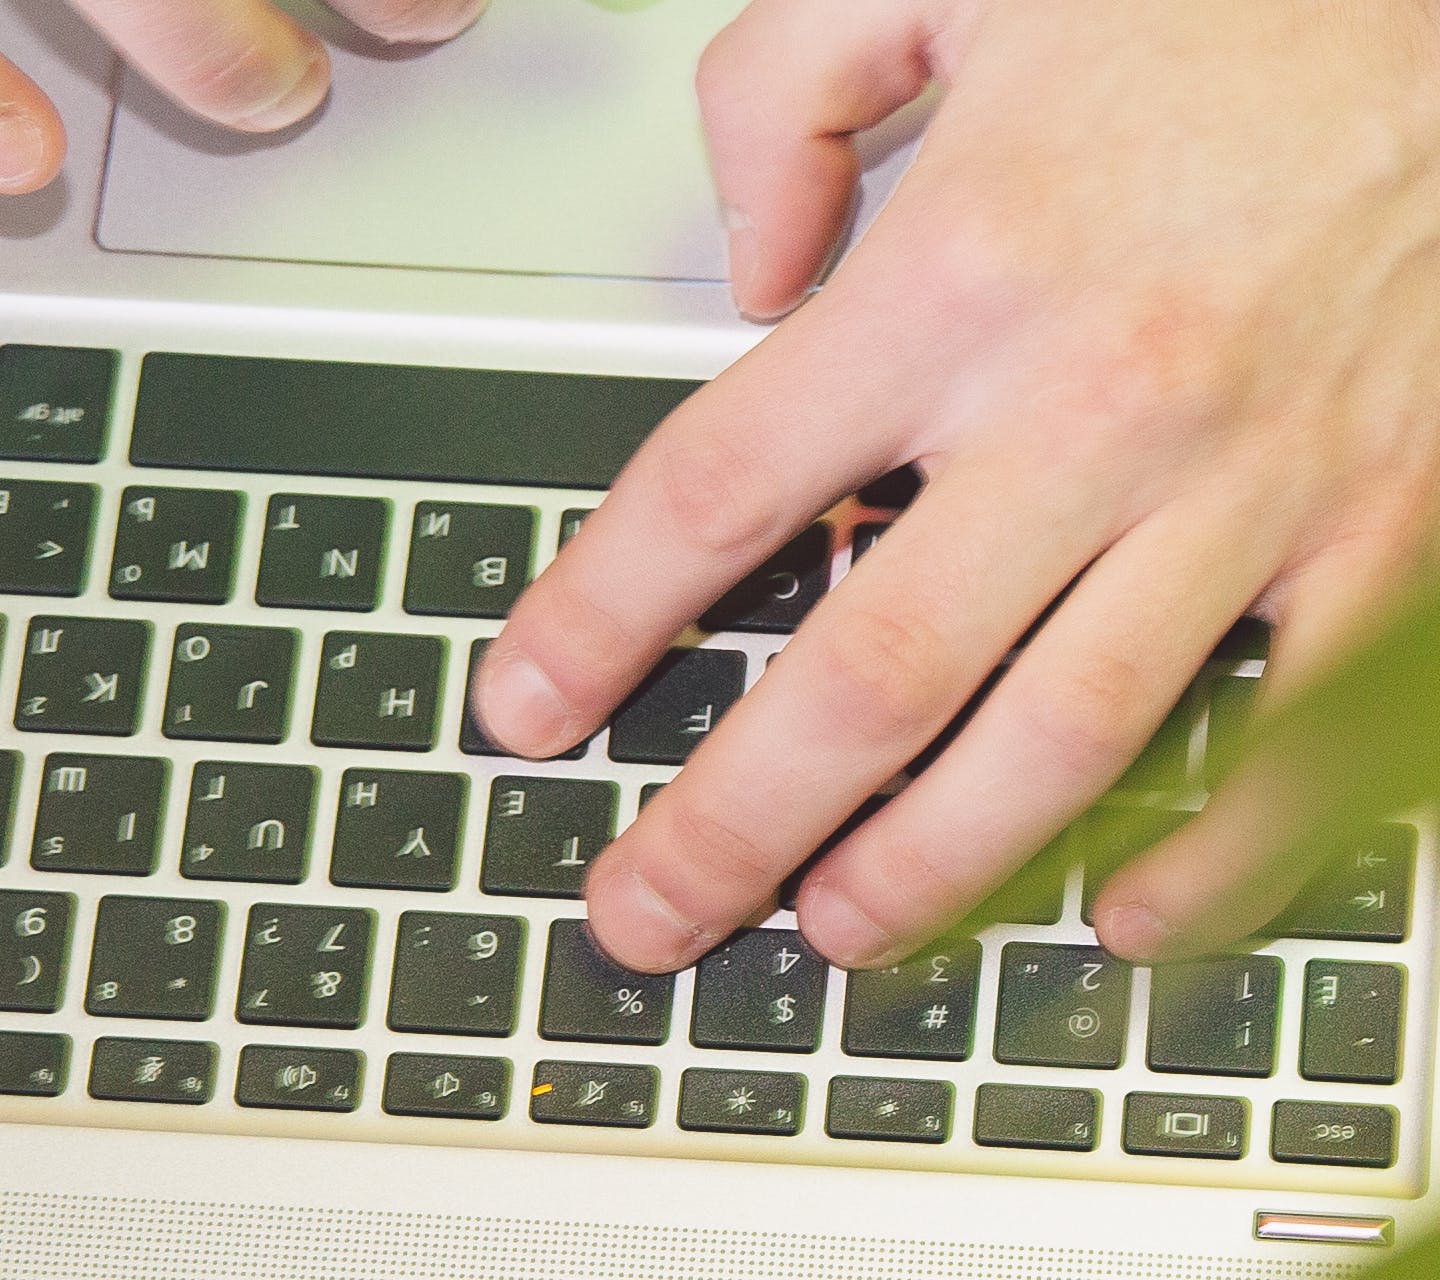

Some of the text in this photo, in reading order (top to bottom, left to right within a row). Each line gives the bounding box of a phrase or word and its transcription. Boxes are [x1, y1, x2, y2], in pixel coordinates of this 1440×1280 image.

[420, 511, 451, 539] И
[169, 540, 211, 571] M
[320, 547, 359, 579] N
[472, 555, 508, 588] B
[80, 672, 119, 704] K
[237, 679, 269, 710] J
[380, 686, 416, 719] H
[681, 703, 713, 733] F
[46, 765, 87, 793] Ш
[40, 835, 66, 856] 5
[247, 818, 285, 850] U
[396, 826, 432, 859] Y
[190, 843, 215, 862] 4
[553, 835, 586, 868] T
[16, 906, 48, 937] 9
[166, 915, 197, 946] 8
[317, 922, 347, 953] 7
[470, 930, 499, 961] 6
[775, 946, 801, 975] 4
[929, 955, 952, 983] 3
[94, 980, 120, 1002] 8
[312, 970, 343, 999] &
[1080, 962, 1104, 991] 2
[1235, 971, 1254, 1002] 1
[1315, 974, 1338, 1006] Ё
[616, 987, 644, 1015] %
[772, 993, 797, 1024] $
[924, 1004, 950, 1030] #
[1067, 1007, 1101, 1039] @
[31, 1067, 55, 1084] f9
[180, 1075, 203, 1093] f8
[329, 1083, 349, 1101] f7
[475, 1090, 497, 1108] f6
[625, 1099, 644, 1116] f5
[775, 1107, 792, 1123] f4
[924, 1114, 940, 1131] f3
[1073, 1122, 1089, 1140] f2
[1310, 1123, 1356, 1142] esc
[1225, 1131, 1238, 1147] f1
